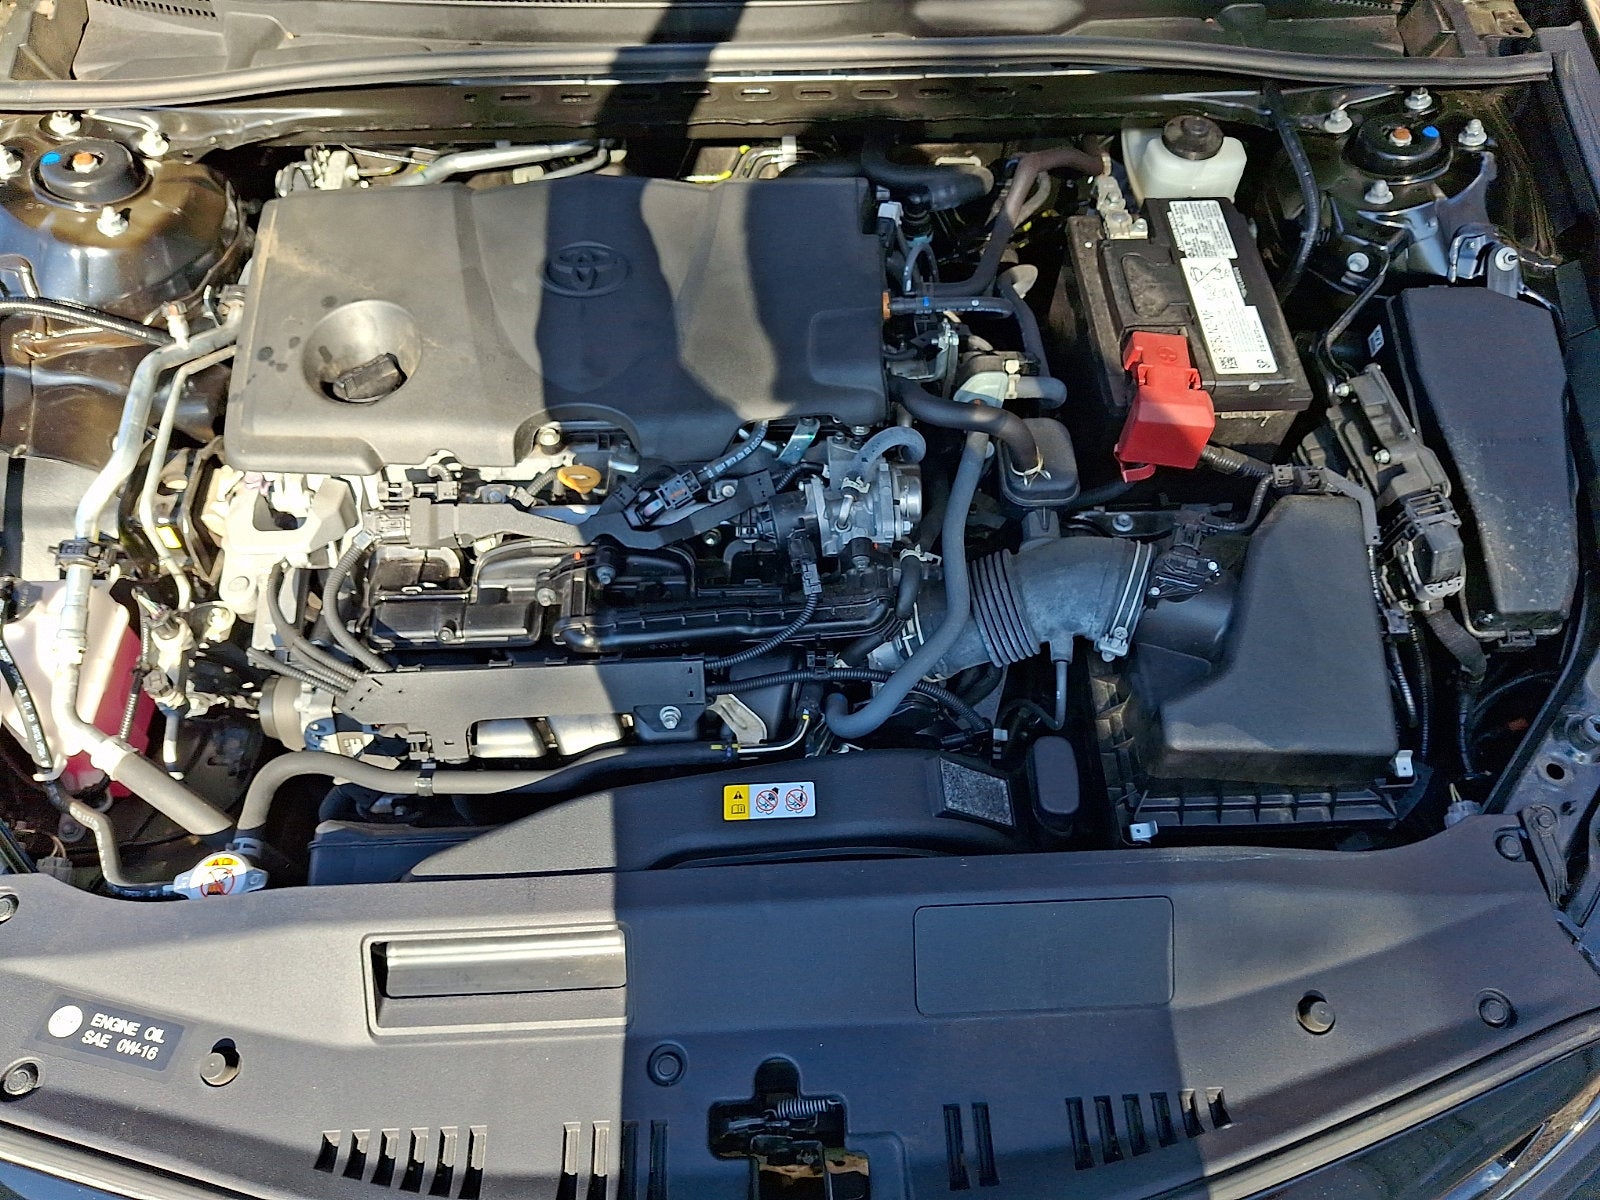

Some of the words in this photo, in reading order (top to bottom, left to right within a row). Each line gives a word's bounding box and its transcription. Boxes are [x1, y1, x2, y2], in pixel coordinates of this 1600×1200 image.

[90, 1012, 141, 1037] ENGINE
[144, 1026, 165, 1044] OIL
[81, 1029, 113, 1049] SAE
[116, 1038, 159, 1061] 0W-16
